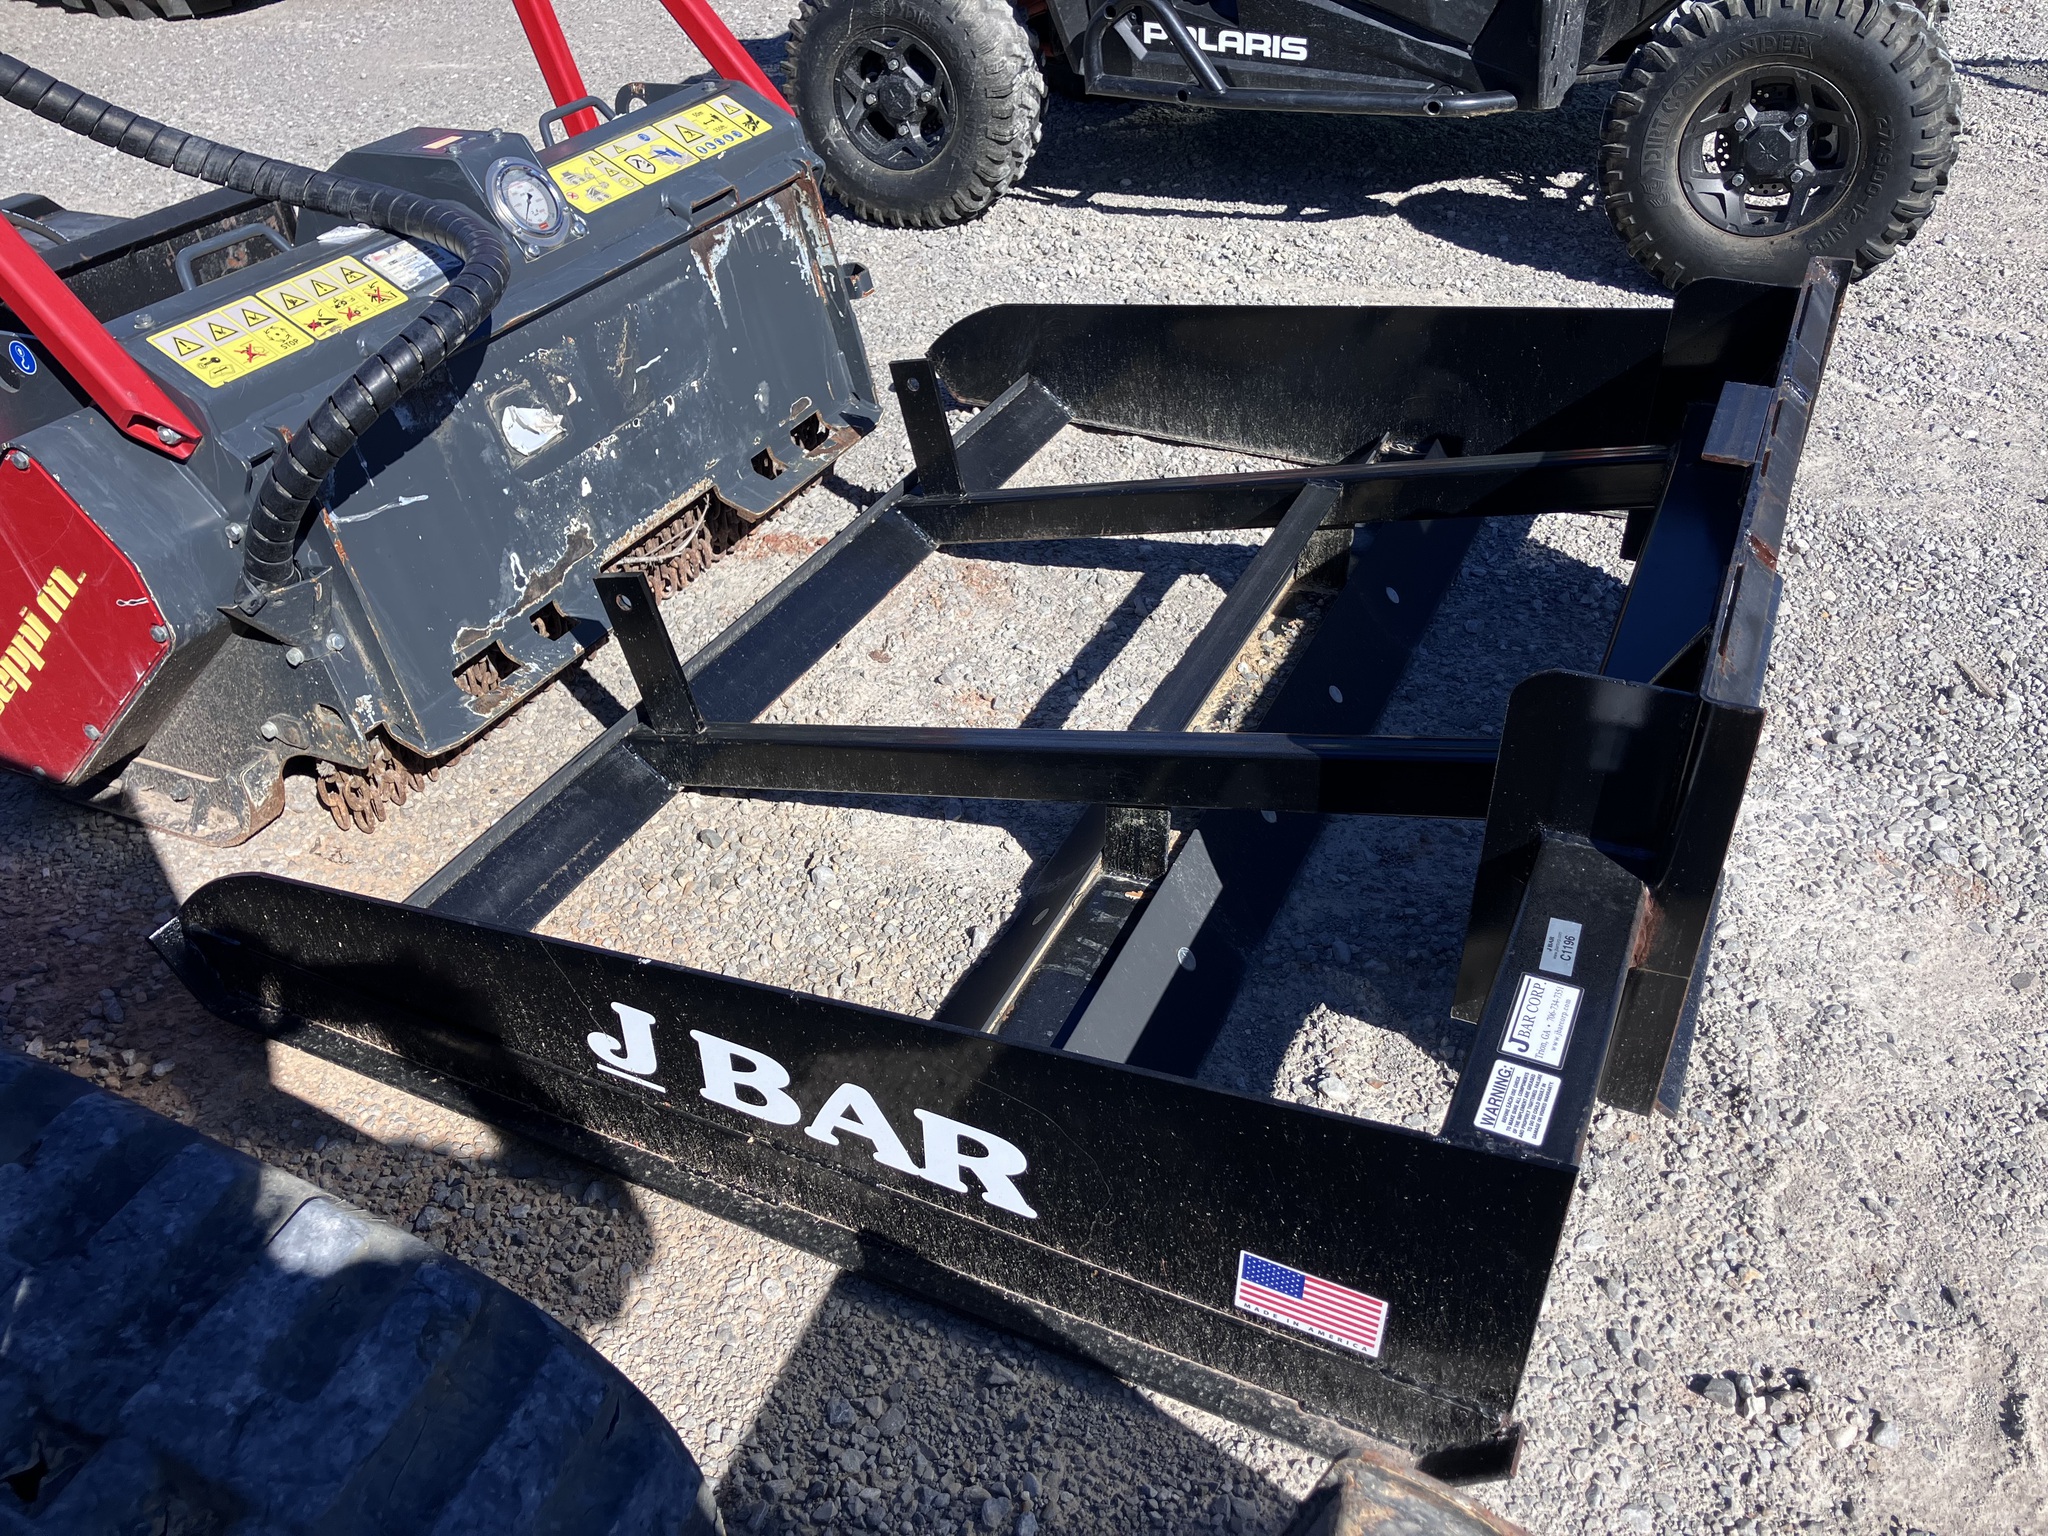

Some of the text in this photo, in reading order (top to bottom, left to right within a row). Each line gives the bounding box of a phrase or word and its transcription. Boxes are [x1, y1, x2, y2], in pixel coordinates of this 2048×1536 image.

[1143, 22, 1308, 61] PLARIS
[1643, 33, 1813, 167] DIRT COMMANDER
[1805, 218, 1852, 255] NHS
[280, 338, 299, 350] STOP
[0, 605, 51, 715] eppi
[1560, 935, 1575, 961] C1196
[1526, 982, 1547, 1013] CORP.
[1518, 1014, 1536, 1038] BAR
[1534, 986, 1564, 1059] Trion, GA 706-734-7351
[1551, 998, 1571, 1052] www.jbarcorp.com
[587, 1001, 1038, 1219] J BAR
[1480, 1065, 1513, 1125] WARNING:
[1243, 1303, 1368, 1352] MADE IN AMERICA
